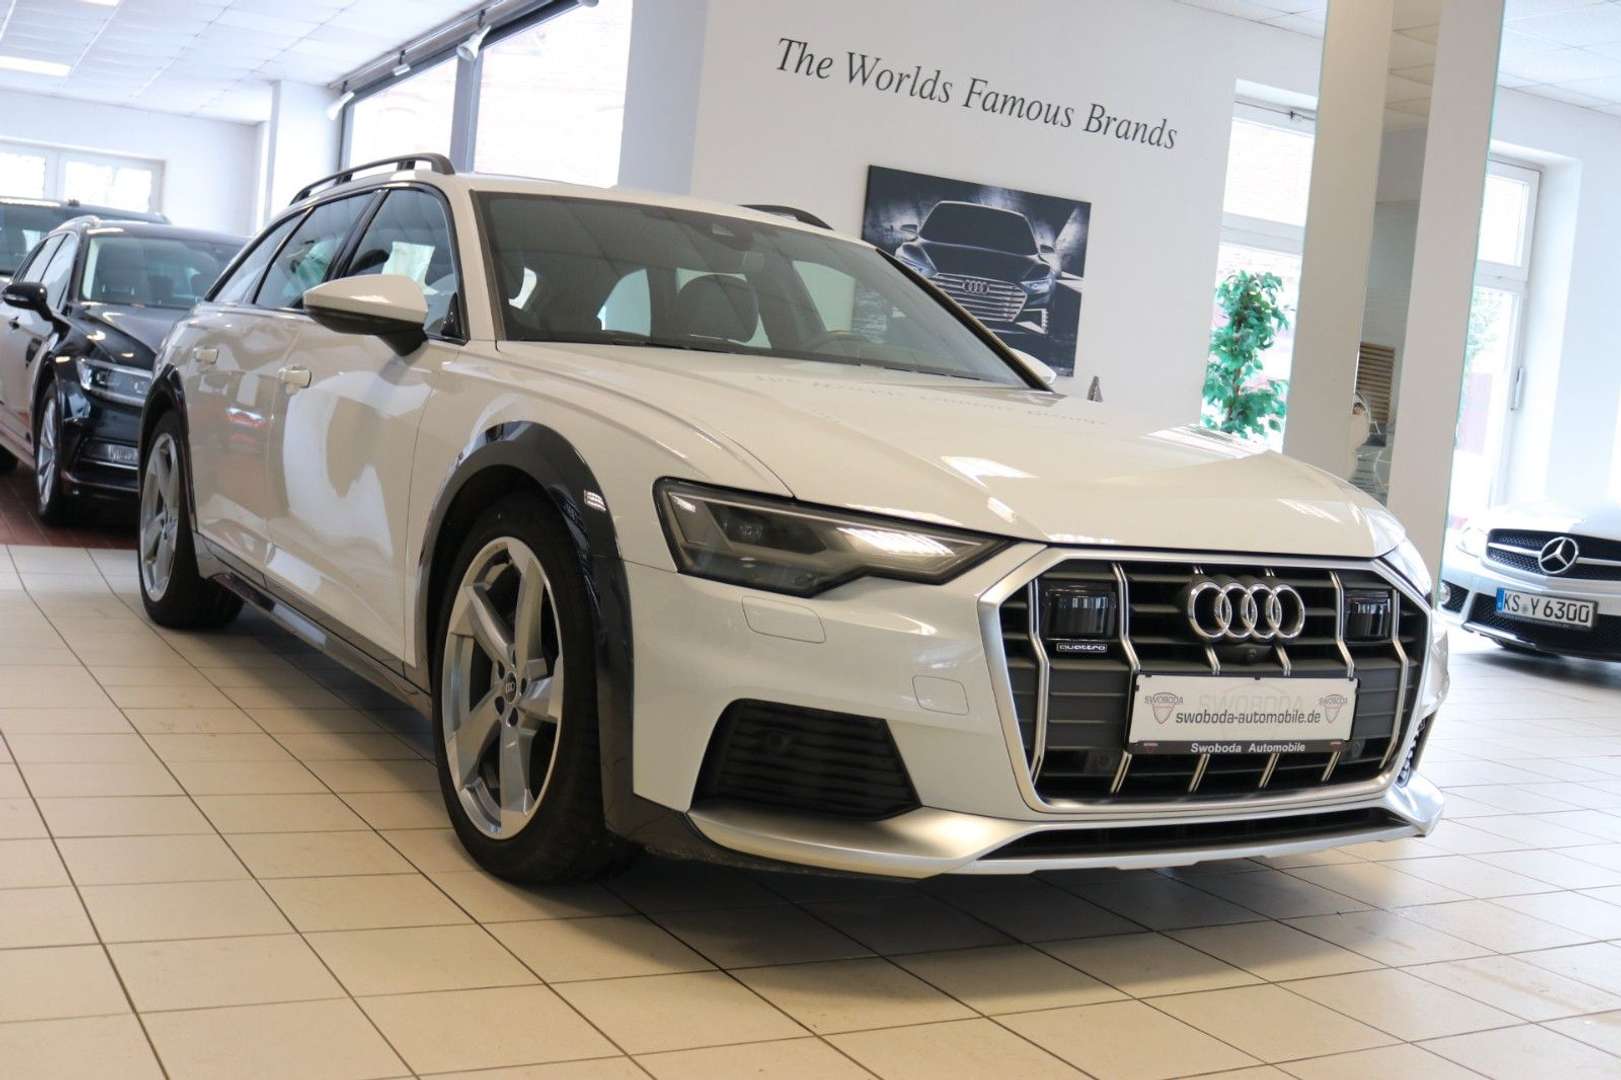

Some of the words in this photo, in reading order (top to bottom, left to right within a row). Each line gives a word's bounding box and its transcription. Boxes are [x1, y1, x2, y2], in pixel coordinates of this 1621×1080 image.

[776, 37, 834, 79] The
[845, 51, 953, 104] Worlds
[962, 77, 1075, 127] Famous
[1083, 103, 1179, 149] Brands
[1503, 593, 1520, 612] KS
[1530, 598, 1540, 616] Y
[1543, 600, 1590, 623] 6300
[1176, 709, 1321, 724] swoboda-automobile.de
[1190, 743, 1242, 753] Swoboda
[1249, 742, 1306, 753] Automobile
